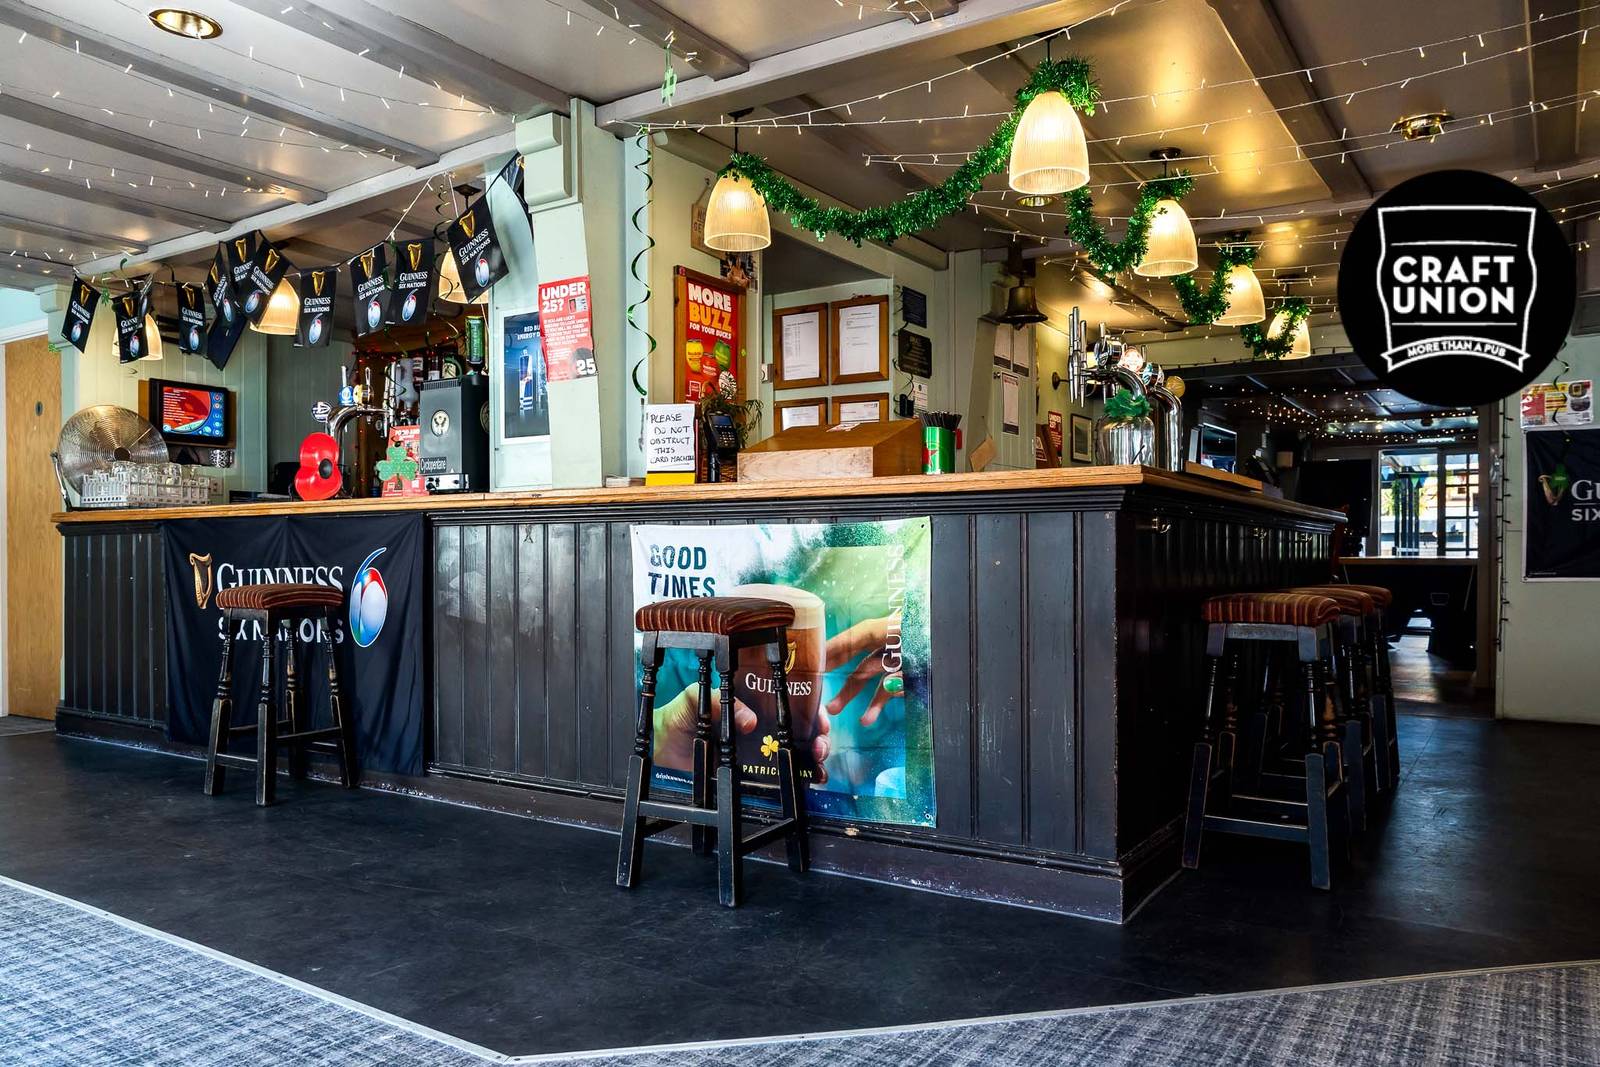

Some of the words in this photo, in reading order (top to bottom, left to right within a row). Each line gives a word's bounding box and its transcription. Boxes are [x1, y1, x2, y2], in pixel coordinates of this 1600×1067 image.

[459, 228, 489, 257] GUINNESS
[461, 257, 470, 266] SIX
[469, 238, 491, 258] NATIONS
[357, 275, 384, 293] GUINNESS
[400, 271, 428, 281] GUINNESS
[407, 281, 427, 289] NATIONS
[365, 285, 385, 298] NATIONS
[541, 281, 586, 300] UNDER
[688, 282, 732, 313] MORE
[304, 296, 331, 306] GUINNESS
[542, 298, 565, 314] 25?
[689, 301, 732, 332] BUZZ
[689, 321, 701, 331] FOR
[701, 325, 716, 336] YOUR
[715, 329, 732, 340] BUCKS
[575, 358, 597, 376] 25
[650, 413, 682, 424] PLEASE
[654, 426, 666, 435] DO
[670, 425, 690, 434] NOT
[650, 436, 690, 446] OBSTRUCT
[650, 455, 669, 464] CARD
[654, 447, 675, 455] THIS
[1571, 508, 1600, 521] SIX
[649, 543, 707, 570] GOOD
[216, 562, 344, 592] GUINNESS
[647, 571, 716, 599] TIMES
[881, 543, 906, 673] GUINNESS
[218, 617, 248, 641] SX
[745, 672, 812, 697] GUINESS
[742, 764, 780, 777] PATRIC
